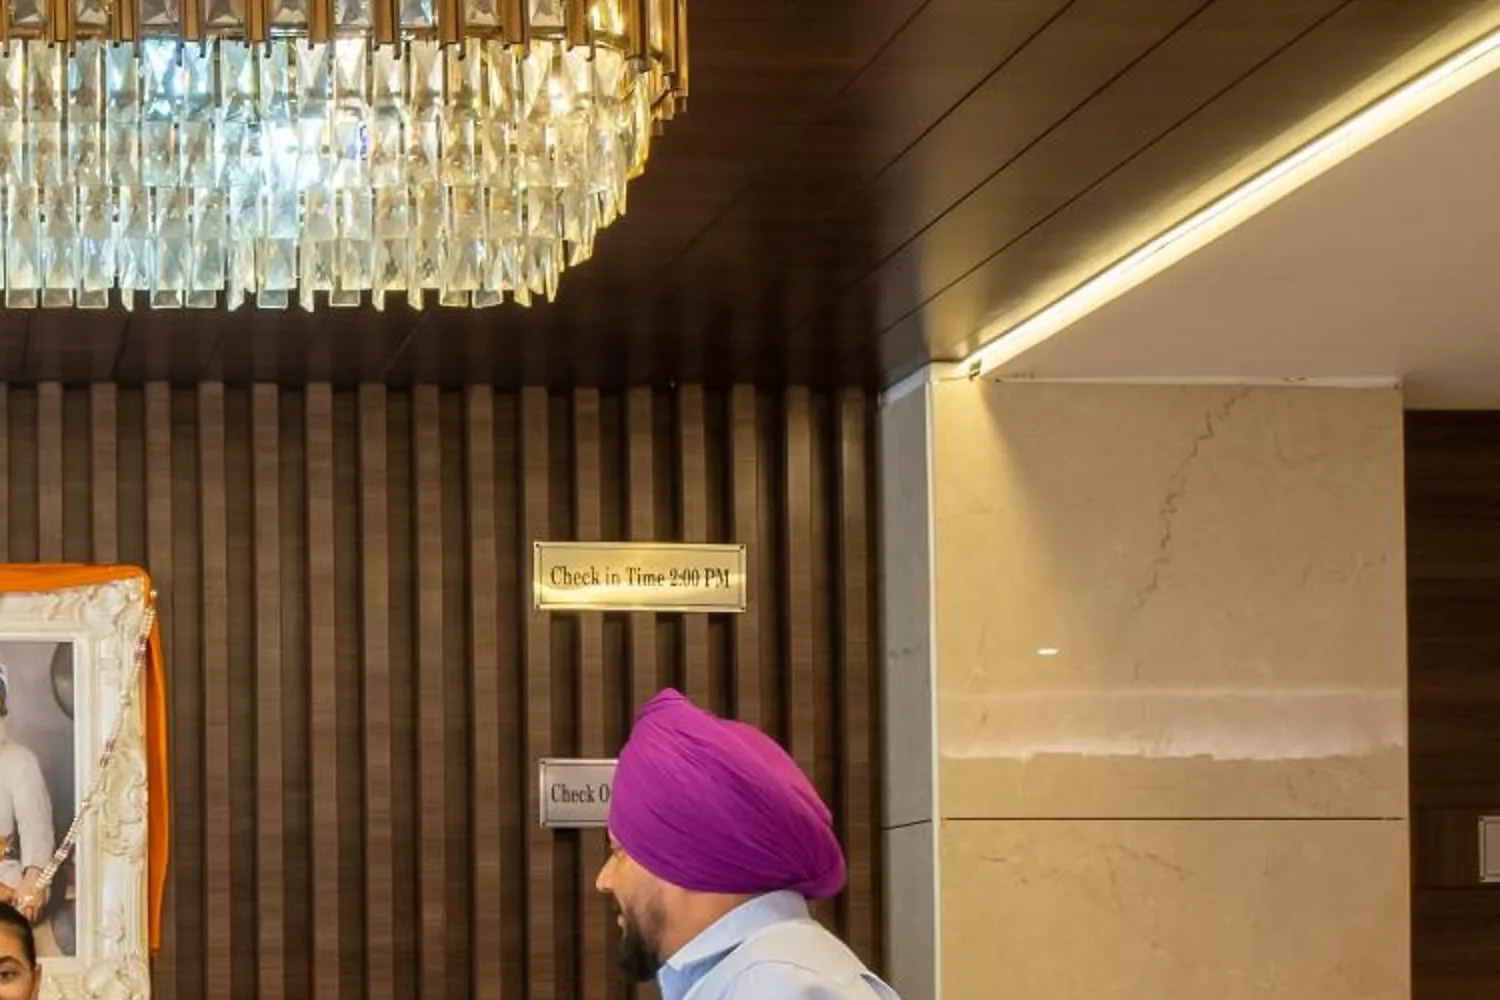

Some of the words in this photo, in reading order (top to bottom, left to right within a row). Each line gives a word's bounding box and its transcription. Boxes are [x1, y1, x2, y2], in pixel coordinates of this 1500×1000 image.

[550, 565, 600, 586] Check
[605, 565, 621, 586] in
[626, 567, 665, 586] Time
[669, 567, 701, 587] 2:00
[704, 568, 730, 588] PM
[551, 783, 596, 803] Check
